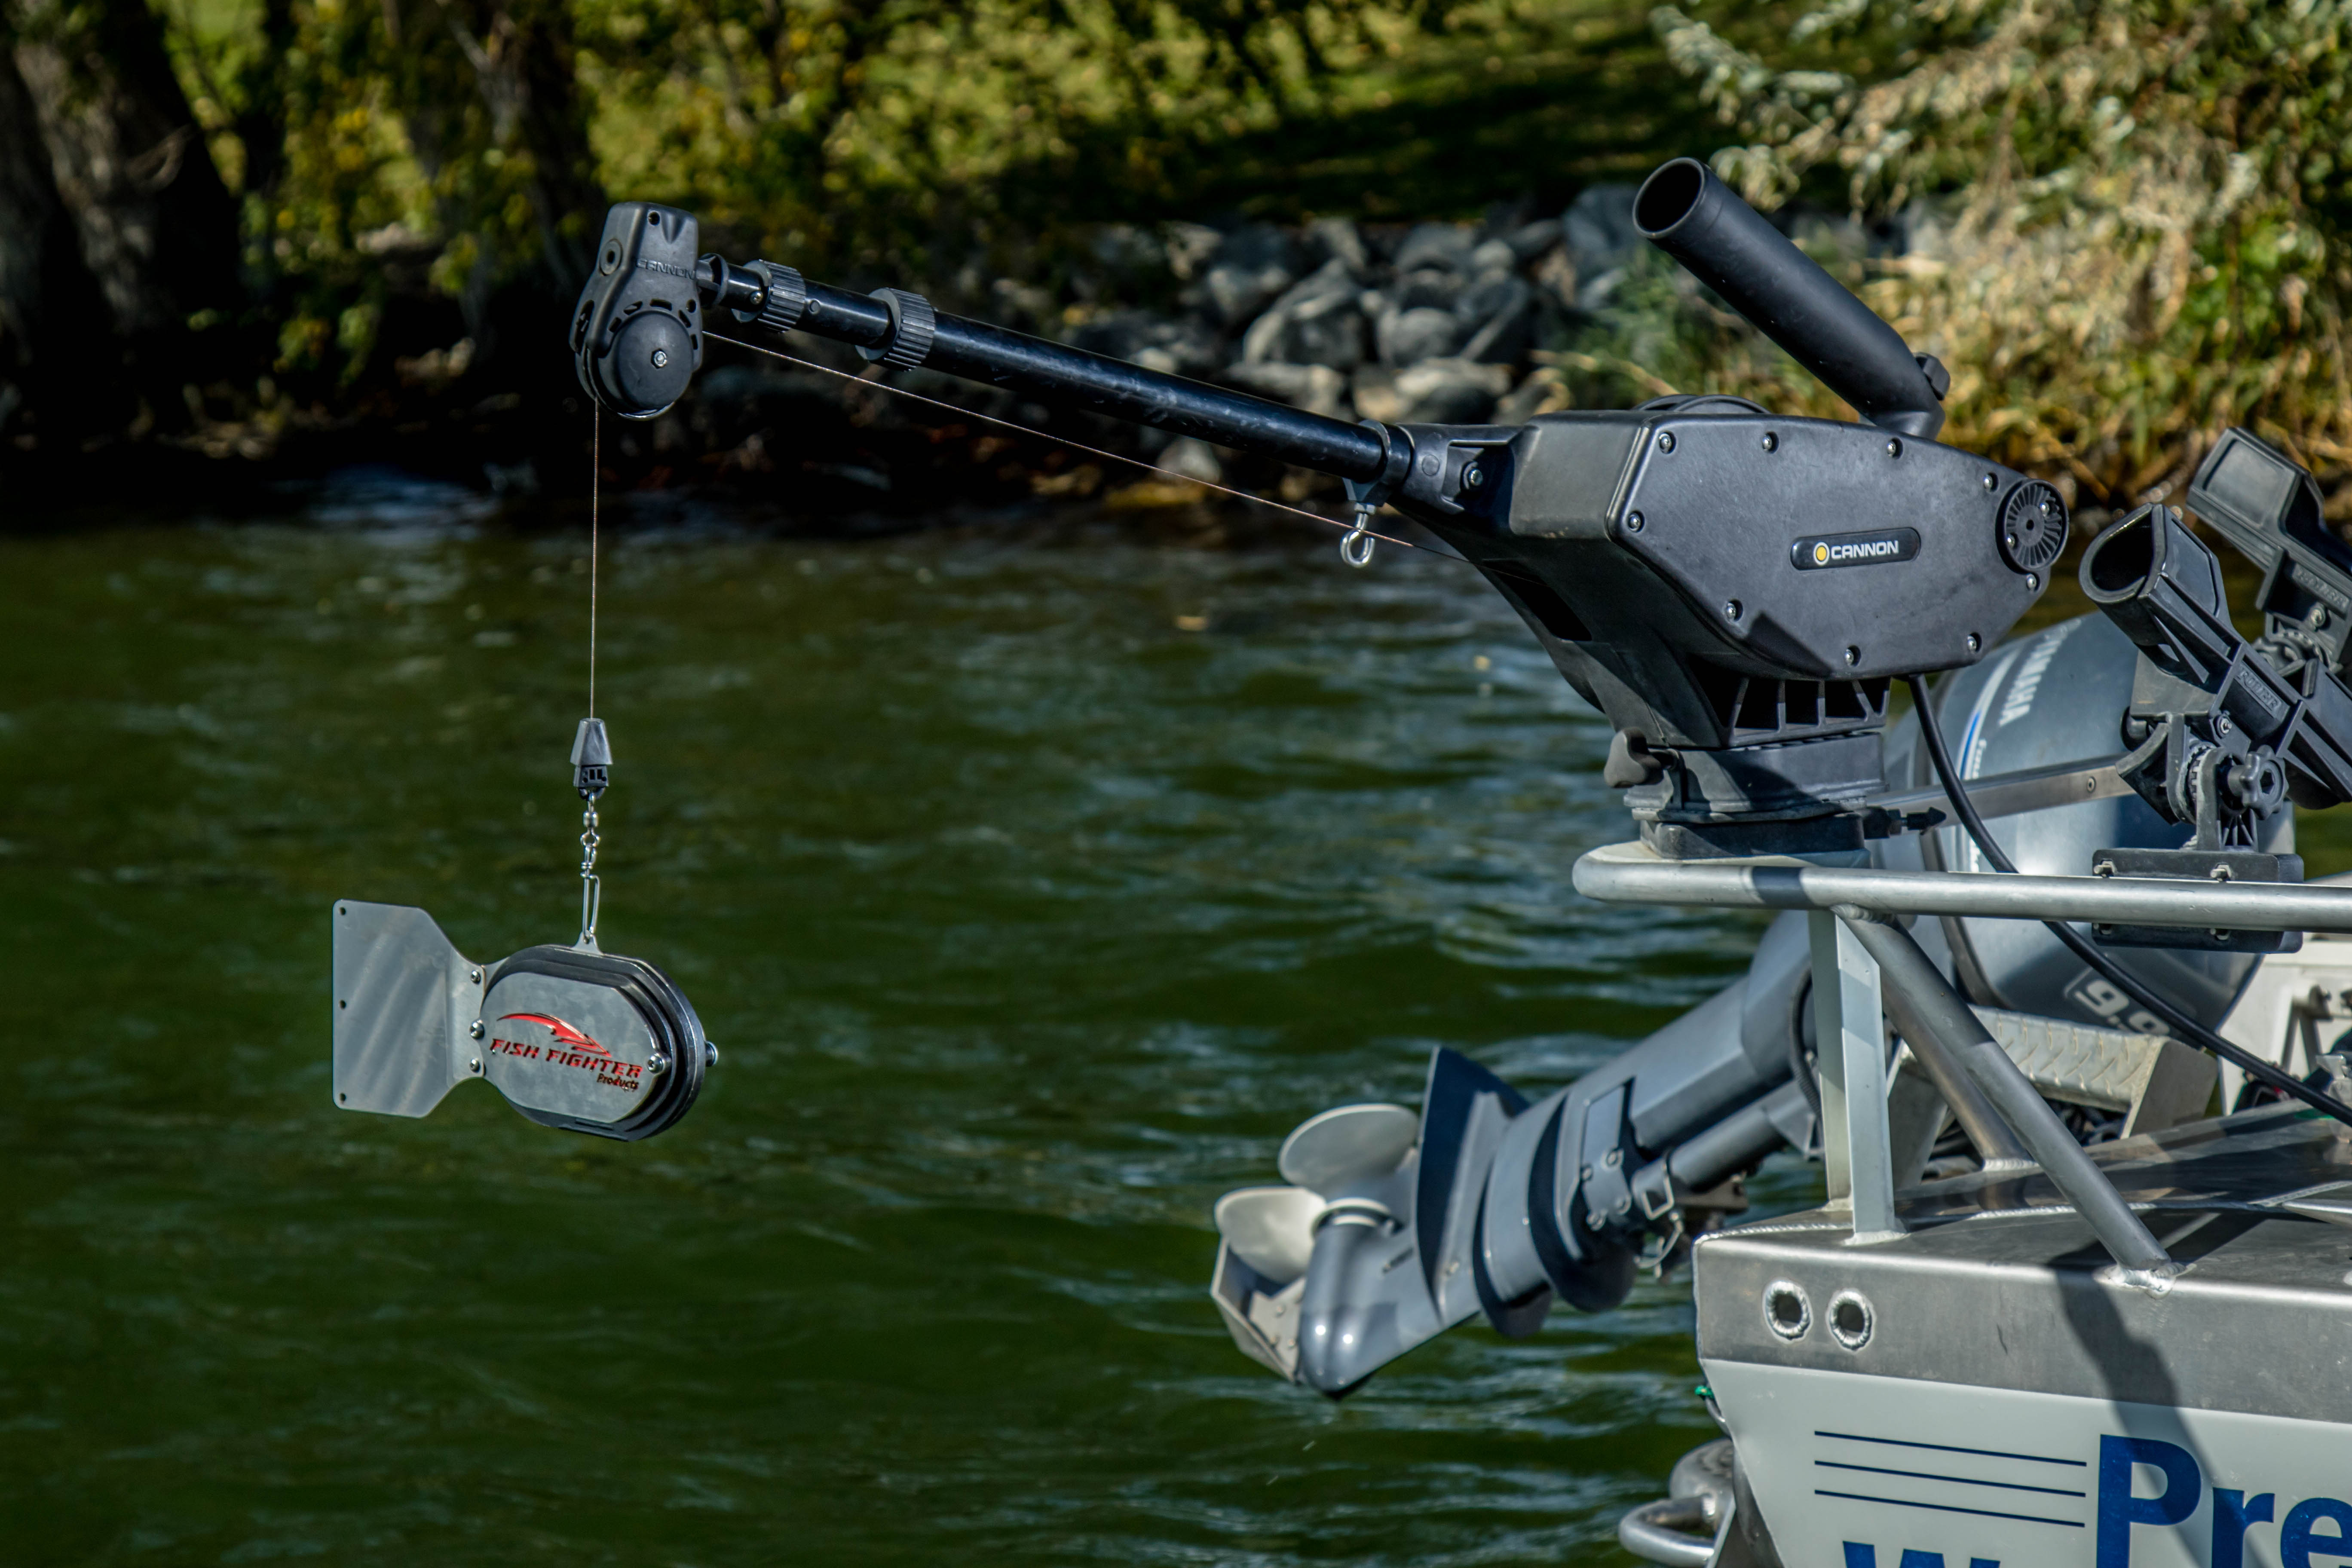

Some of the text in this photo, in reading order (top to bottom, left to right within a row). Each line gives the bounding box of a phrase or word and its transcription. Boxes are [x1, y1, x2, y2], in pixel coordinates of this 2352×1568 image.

[636, 258, 696, 280] CANNON
[1831, 540, 1899, 560] CANNON
[490, 1038, 643, 1078] FISH FIGHTER
[597, 1073, 639, 1090] Products
